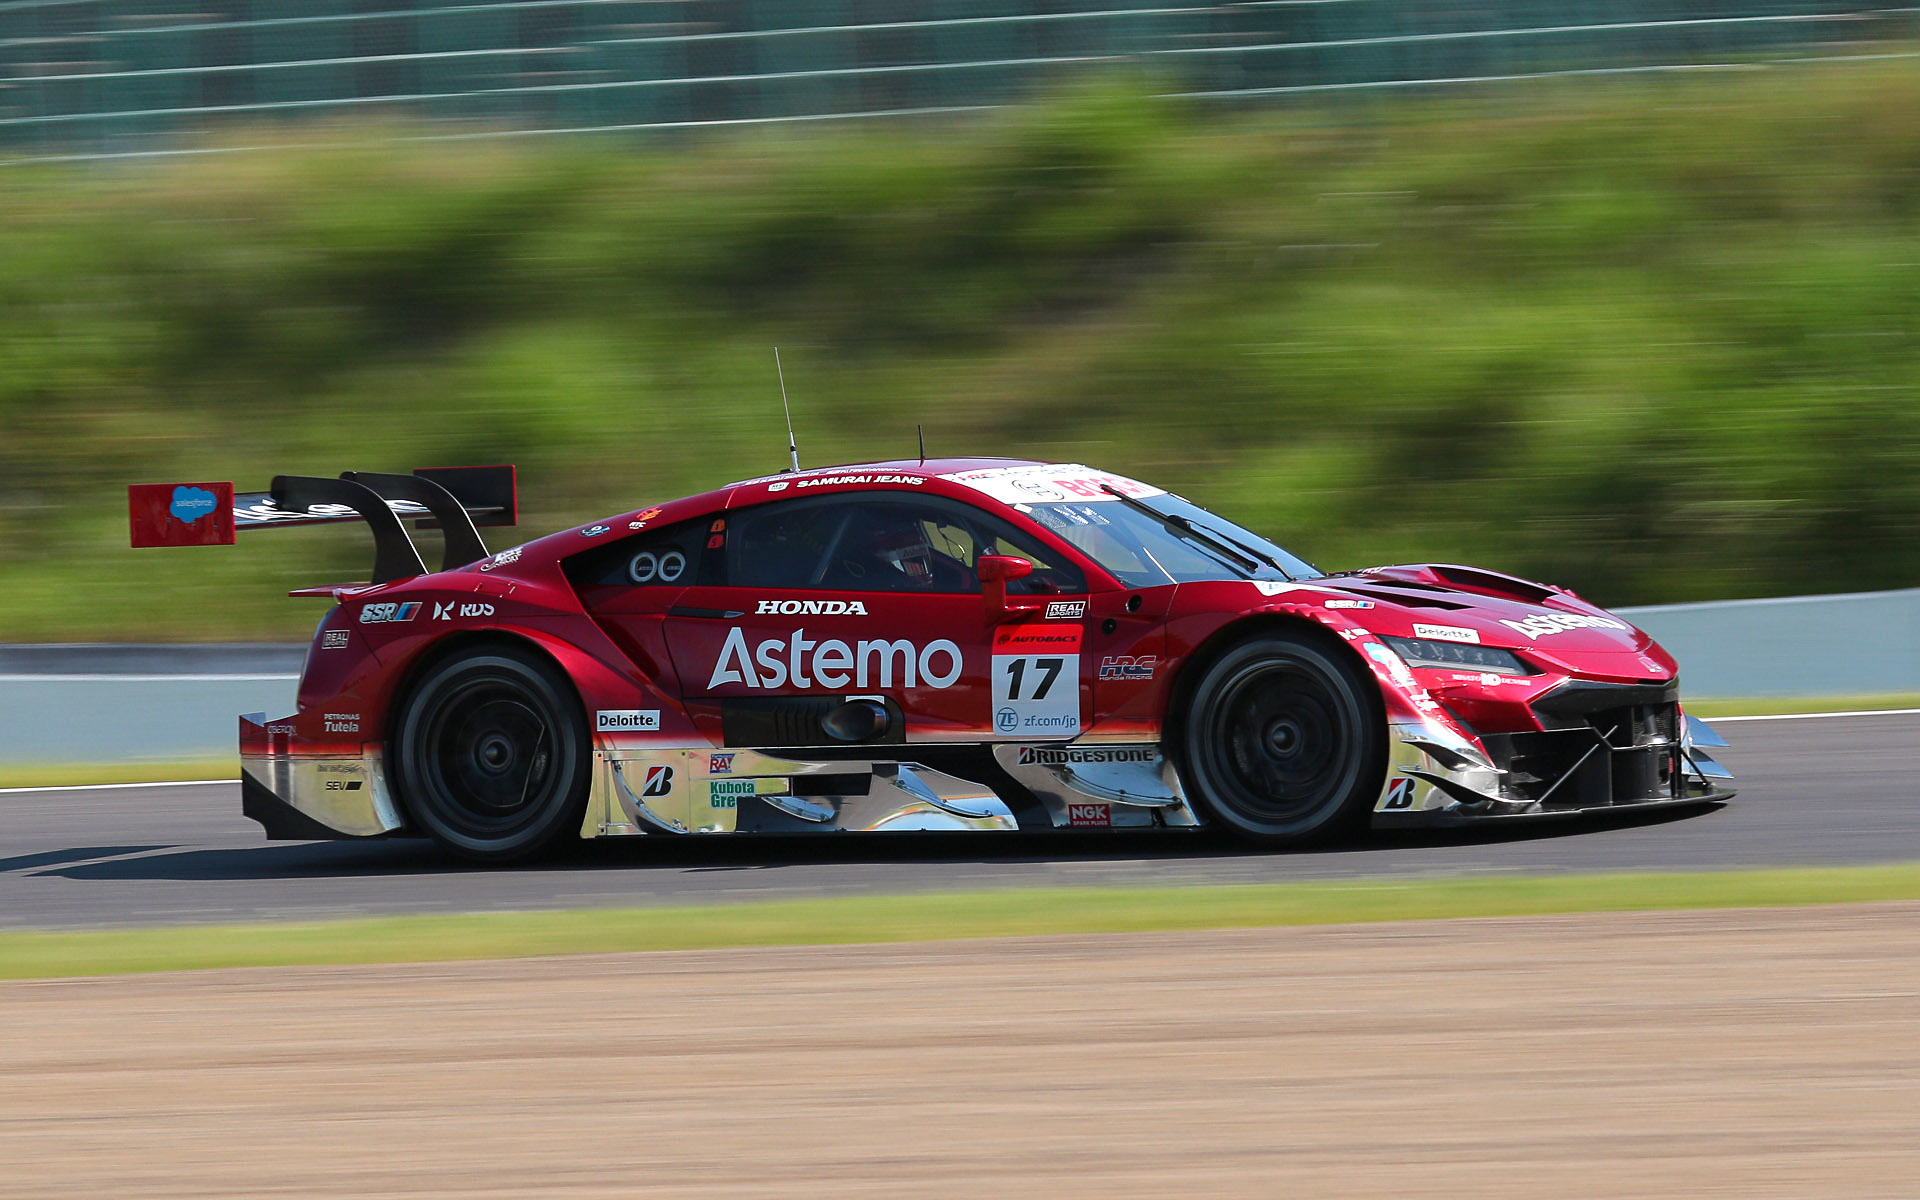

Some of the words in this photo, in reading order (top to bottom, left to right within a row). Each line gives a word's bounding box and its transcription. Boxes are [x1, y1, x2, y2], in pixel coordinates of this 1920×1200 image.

[796, 475, 871, 488] SAMURAI
[873, 475, 925, 486] JEANS
[360, 602, 399, 624] SSR
[755, 600, 868, 615] HONDA
[1050, 603, 1083, 611] REAL
[1498, 613, 1625, 641] Astemo
[325, 632, 348, 641] REAL
[1011, 635, 1078, 643] AUTOBACS
[707, 627, 964, 690] Astemo
[1007, 658, 1064, 700] 17
[999, 712, 1015, 725] ZF
[1024, 715, 1077, 728] zf.com/jp
[324, 721, 360, 732] Tutela
[1018, 746, 1154, 765] BRIDGESTONE
[710, 781, 755, 794] Kubota
[1071, 805, 1107, 820] NGK
